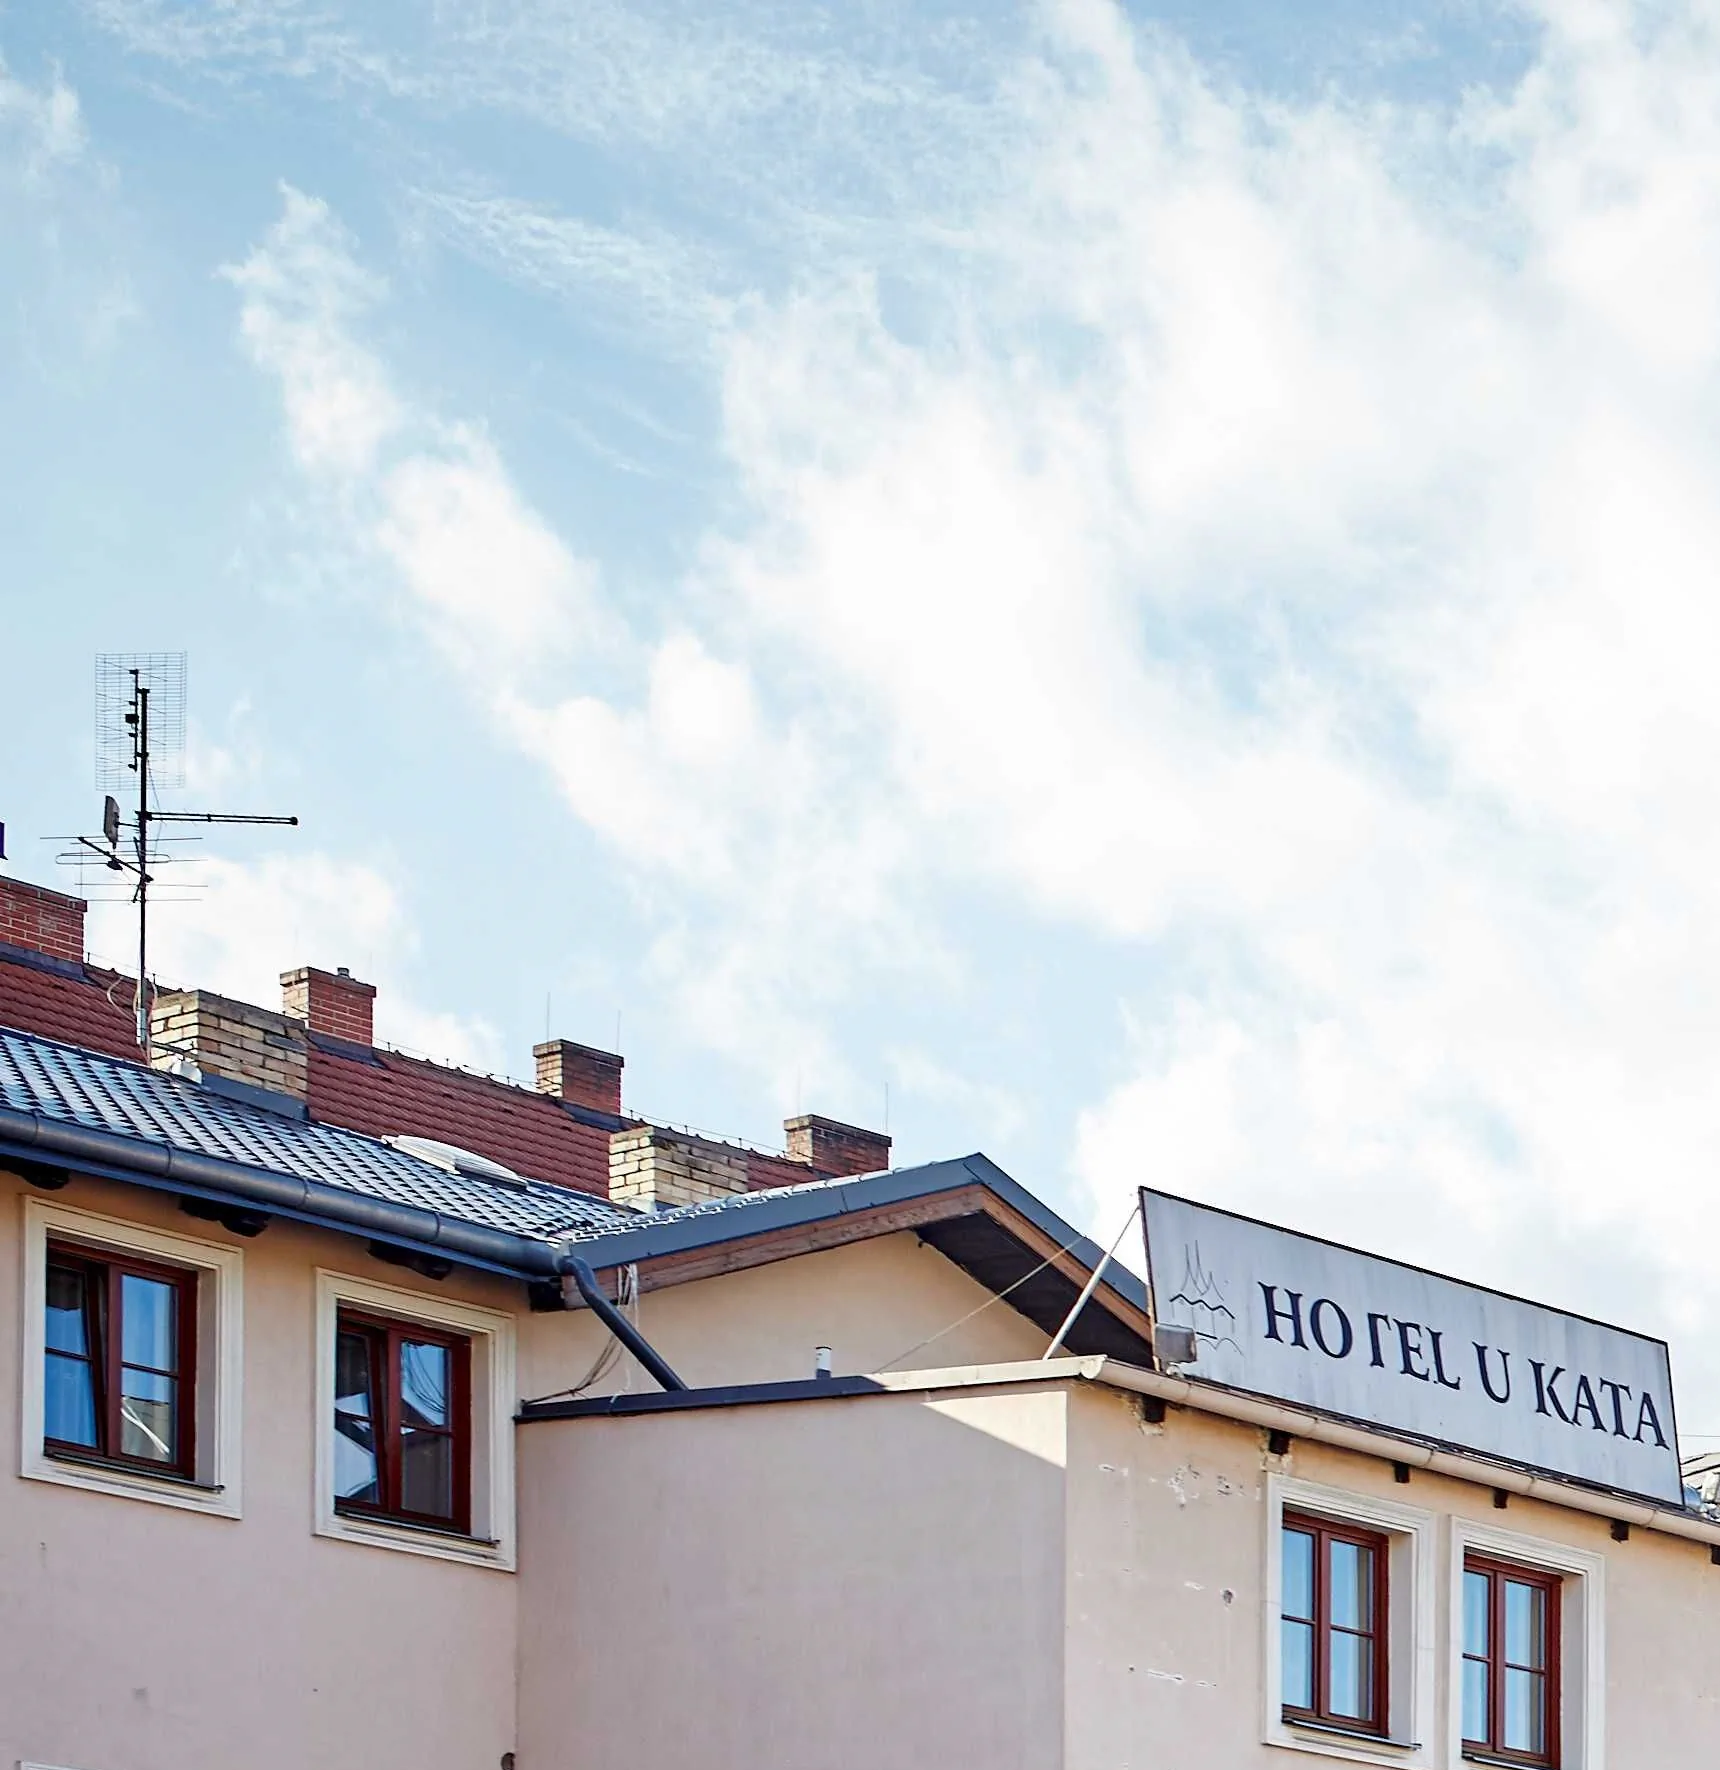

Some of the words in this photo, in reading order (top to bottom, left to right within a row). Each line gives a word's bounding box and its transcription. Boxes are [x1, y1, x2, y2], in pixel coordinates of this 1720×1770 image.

[1256, 1280, 1461, 1392] HOTEL
[1471, 1340, 1511, 1404] U
[1527, 1357, 1670, 1450] KATA
